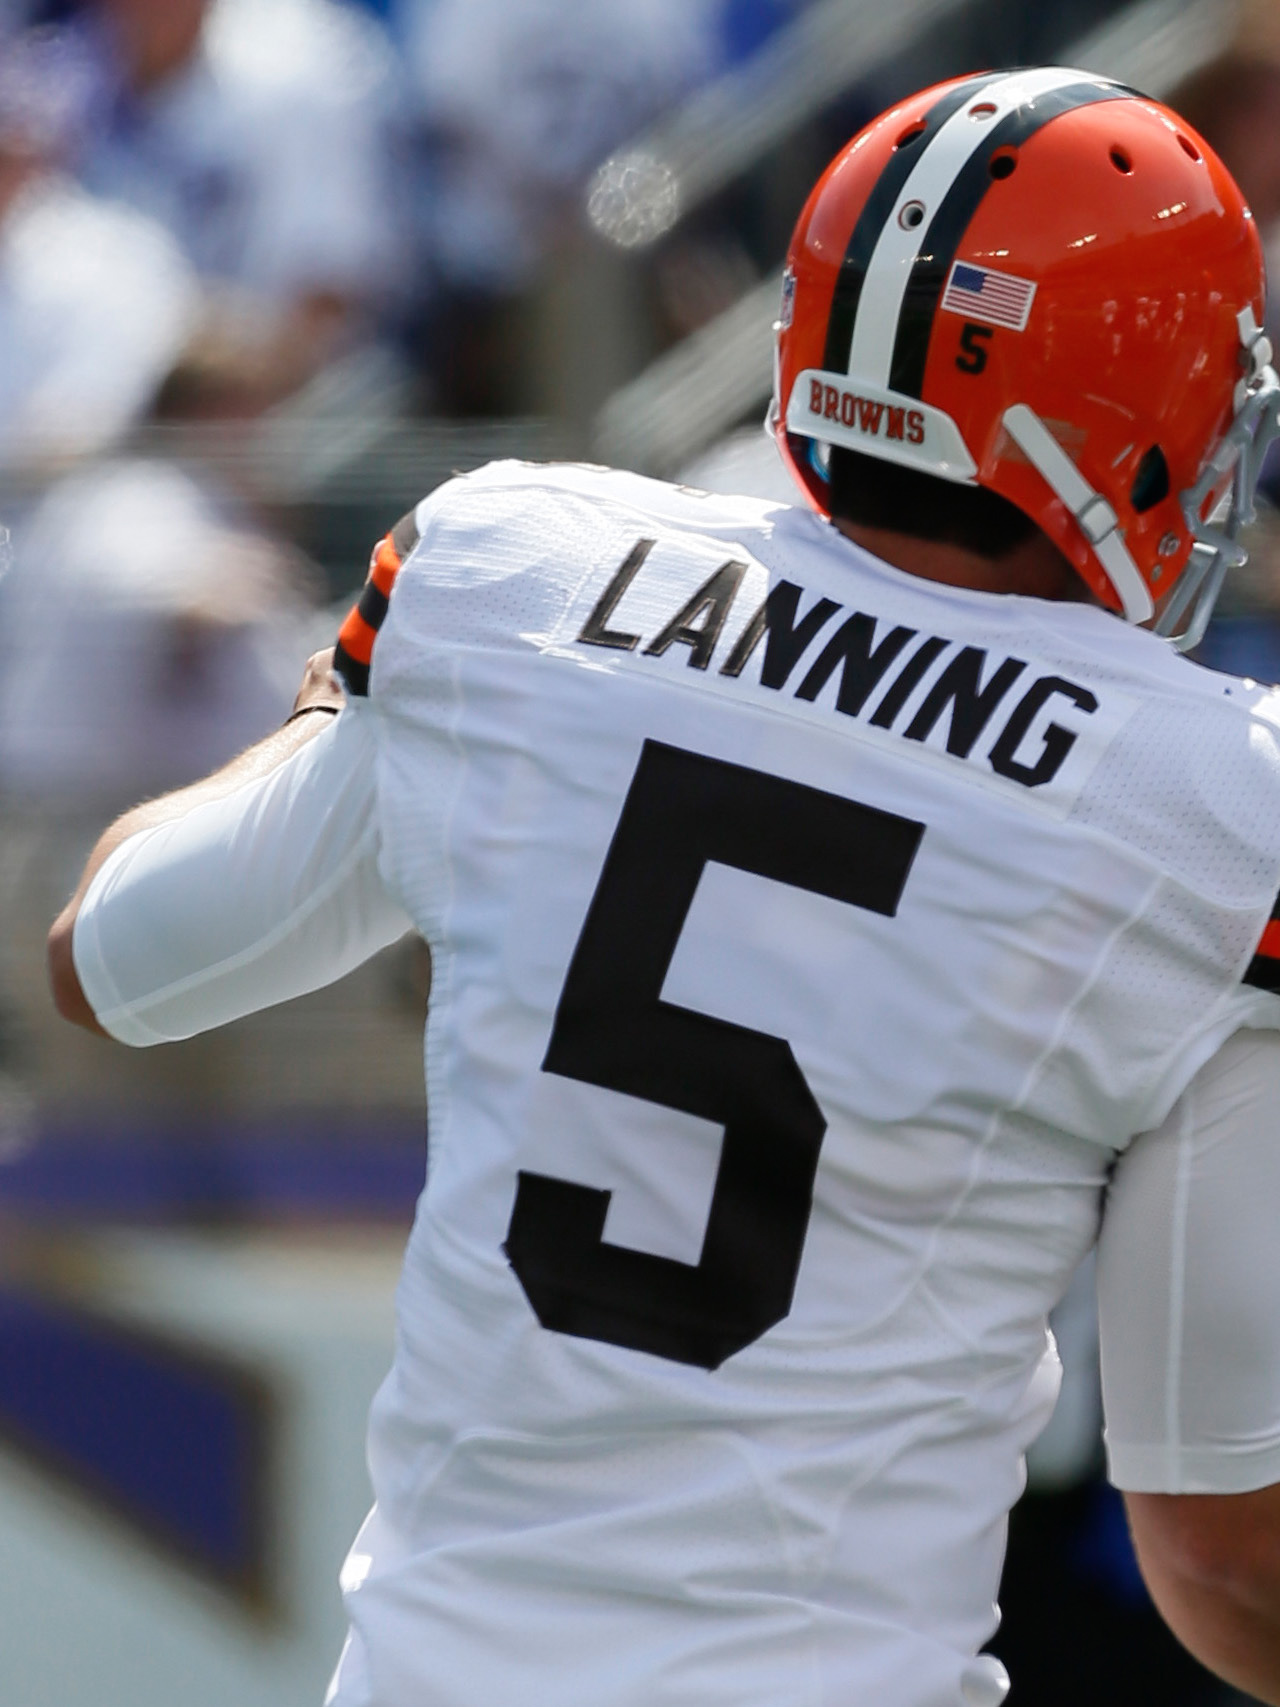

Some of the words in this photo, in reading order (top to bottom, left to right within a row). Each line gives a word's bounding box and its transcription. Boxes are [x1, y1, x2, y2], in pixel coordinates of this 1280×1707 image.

[809, 378, 925, 445] BROWNS
[956, 324, 993, 374] 5
[577, 538, 1100, 788] LANNING
[502, 737, 926, 1372] 5
